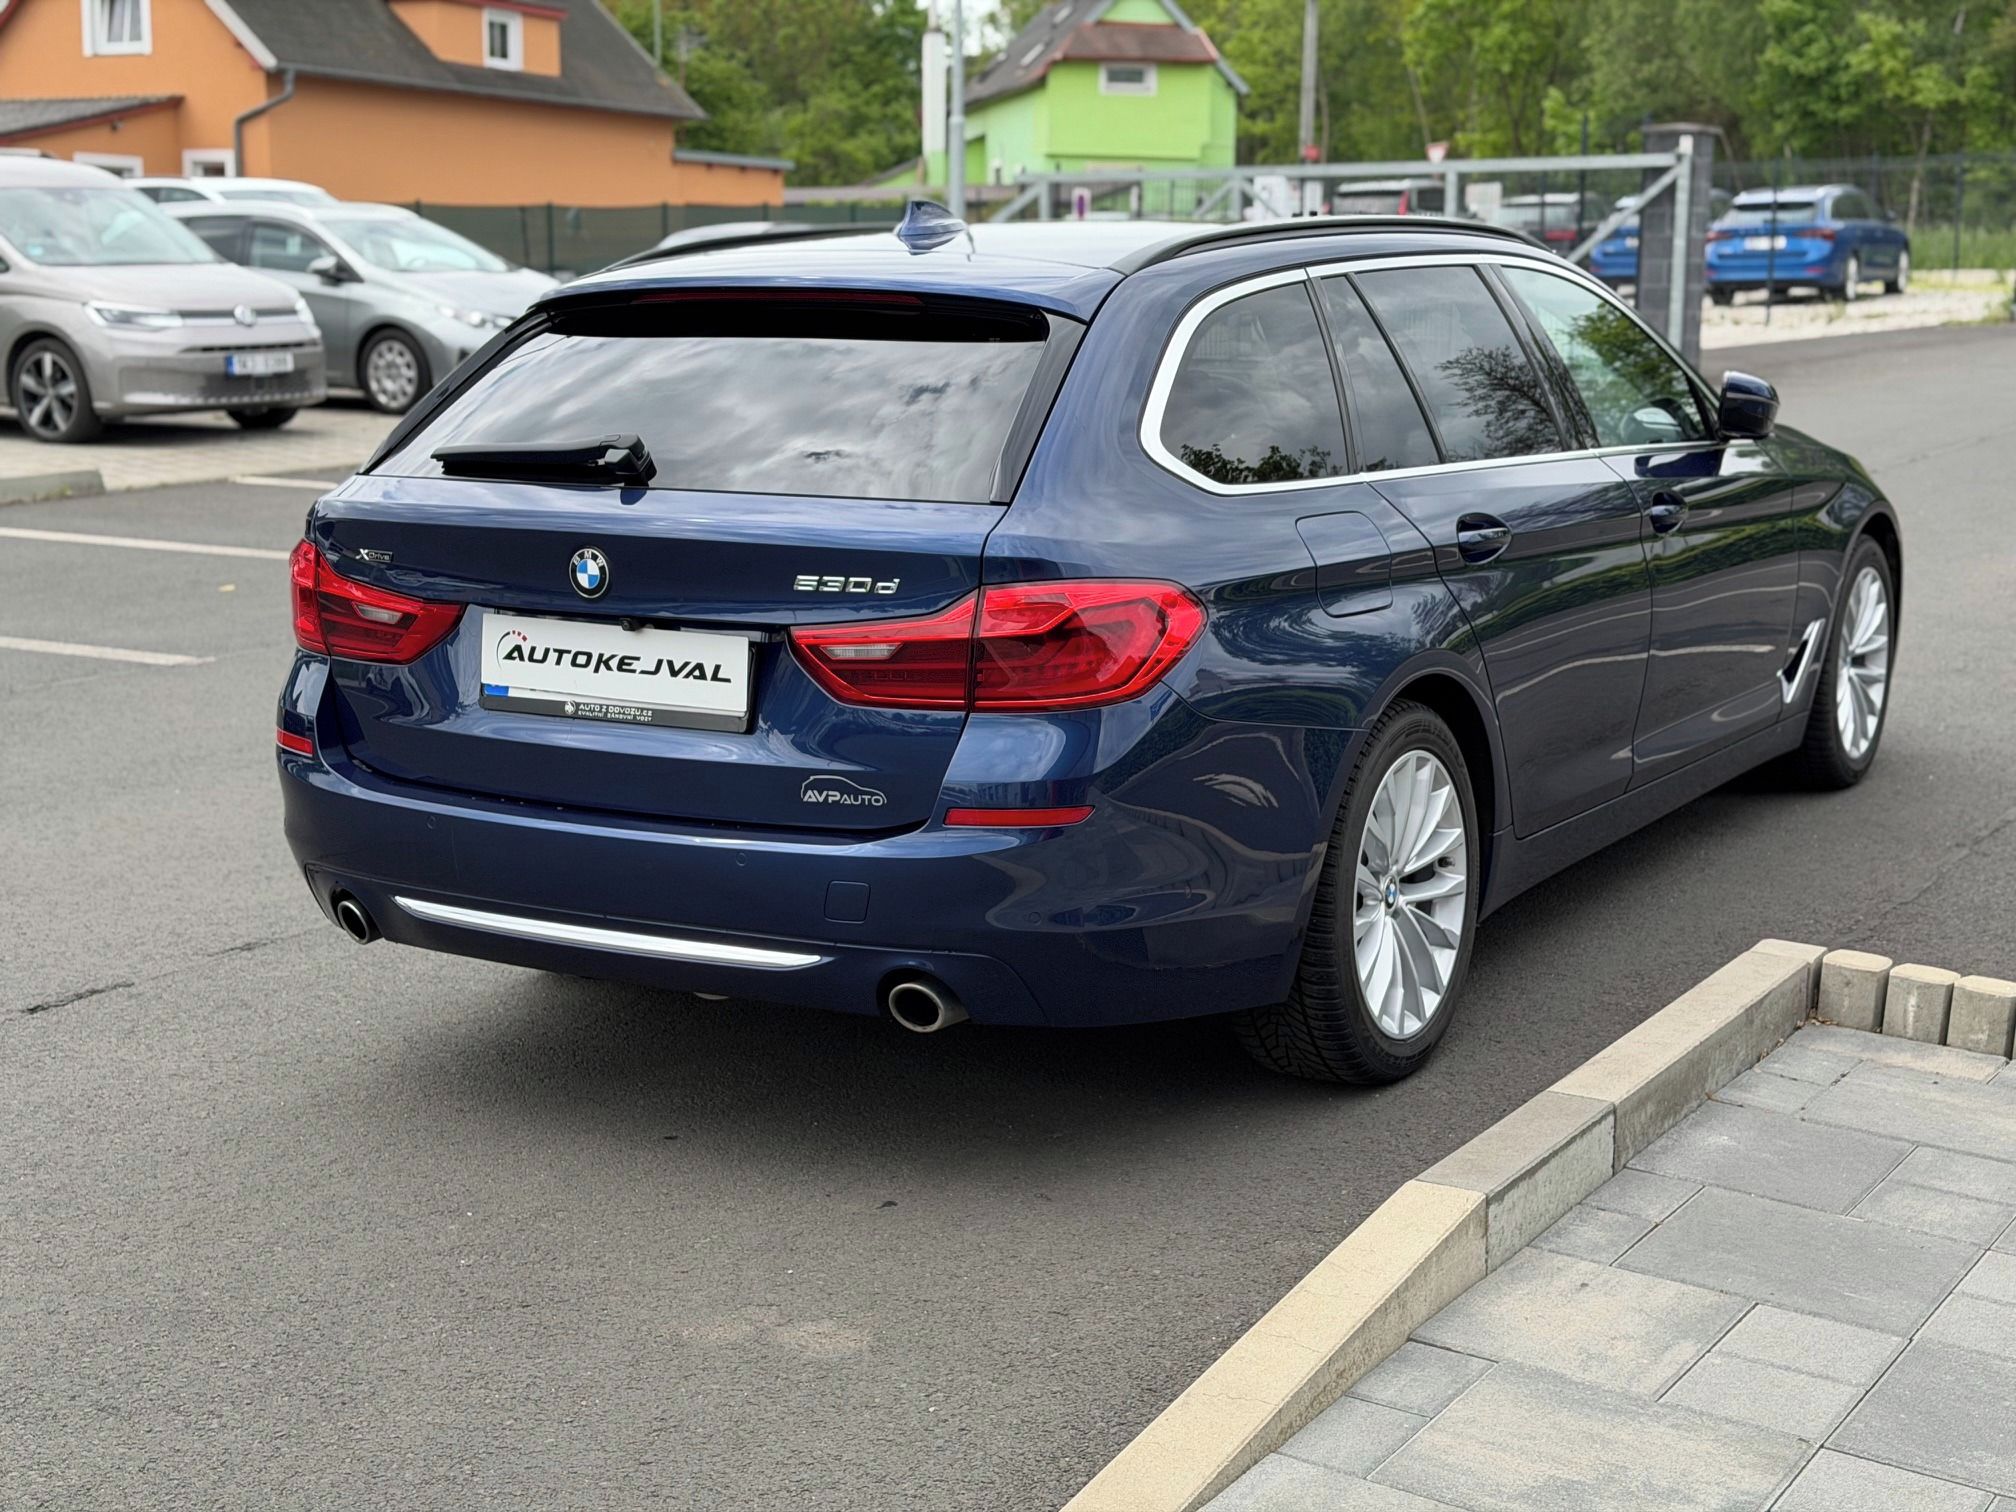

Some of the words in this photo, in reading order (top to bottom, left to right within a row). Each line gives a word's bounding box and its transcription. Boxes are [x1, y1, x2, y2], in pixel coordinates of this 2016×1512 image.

[572, 550, 605, 567] BMW
[793, 575, 901, 594] 530d
[502, 643, 732, 683] AUTOKEJVAL
